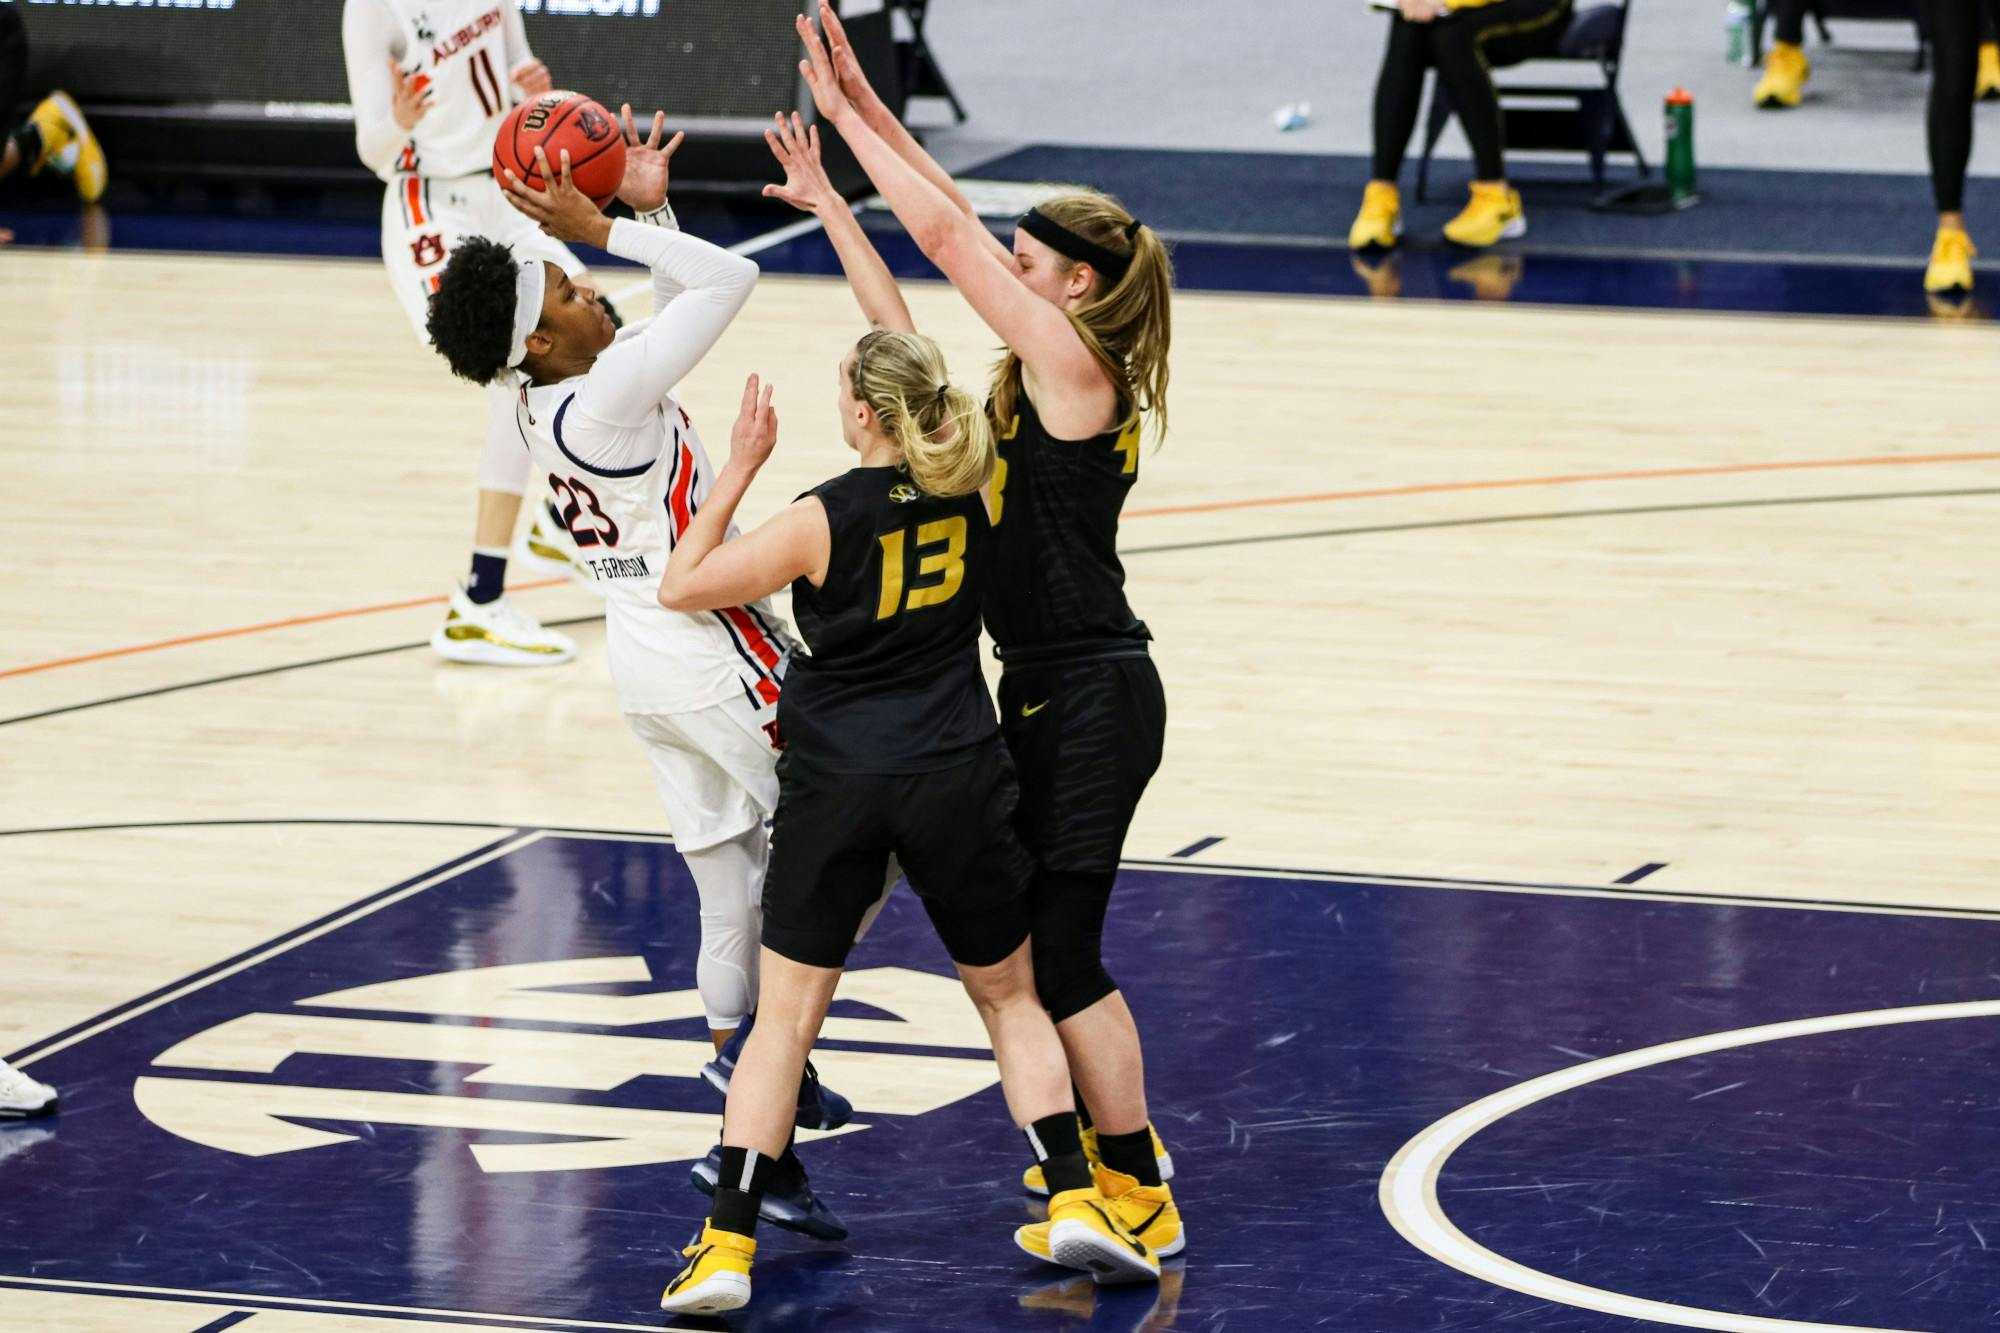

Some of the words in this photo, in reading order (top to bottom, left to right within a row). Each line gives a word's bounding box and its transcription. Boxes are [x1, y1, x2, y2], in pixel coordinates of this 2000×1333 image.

[469, 48, 502, 118] 11
[549, 472, 620, 548] 23
[876, 515, 968, 622] 13
